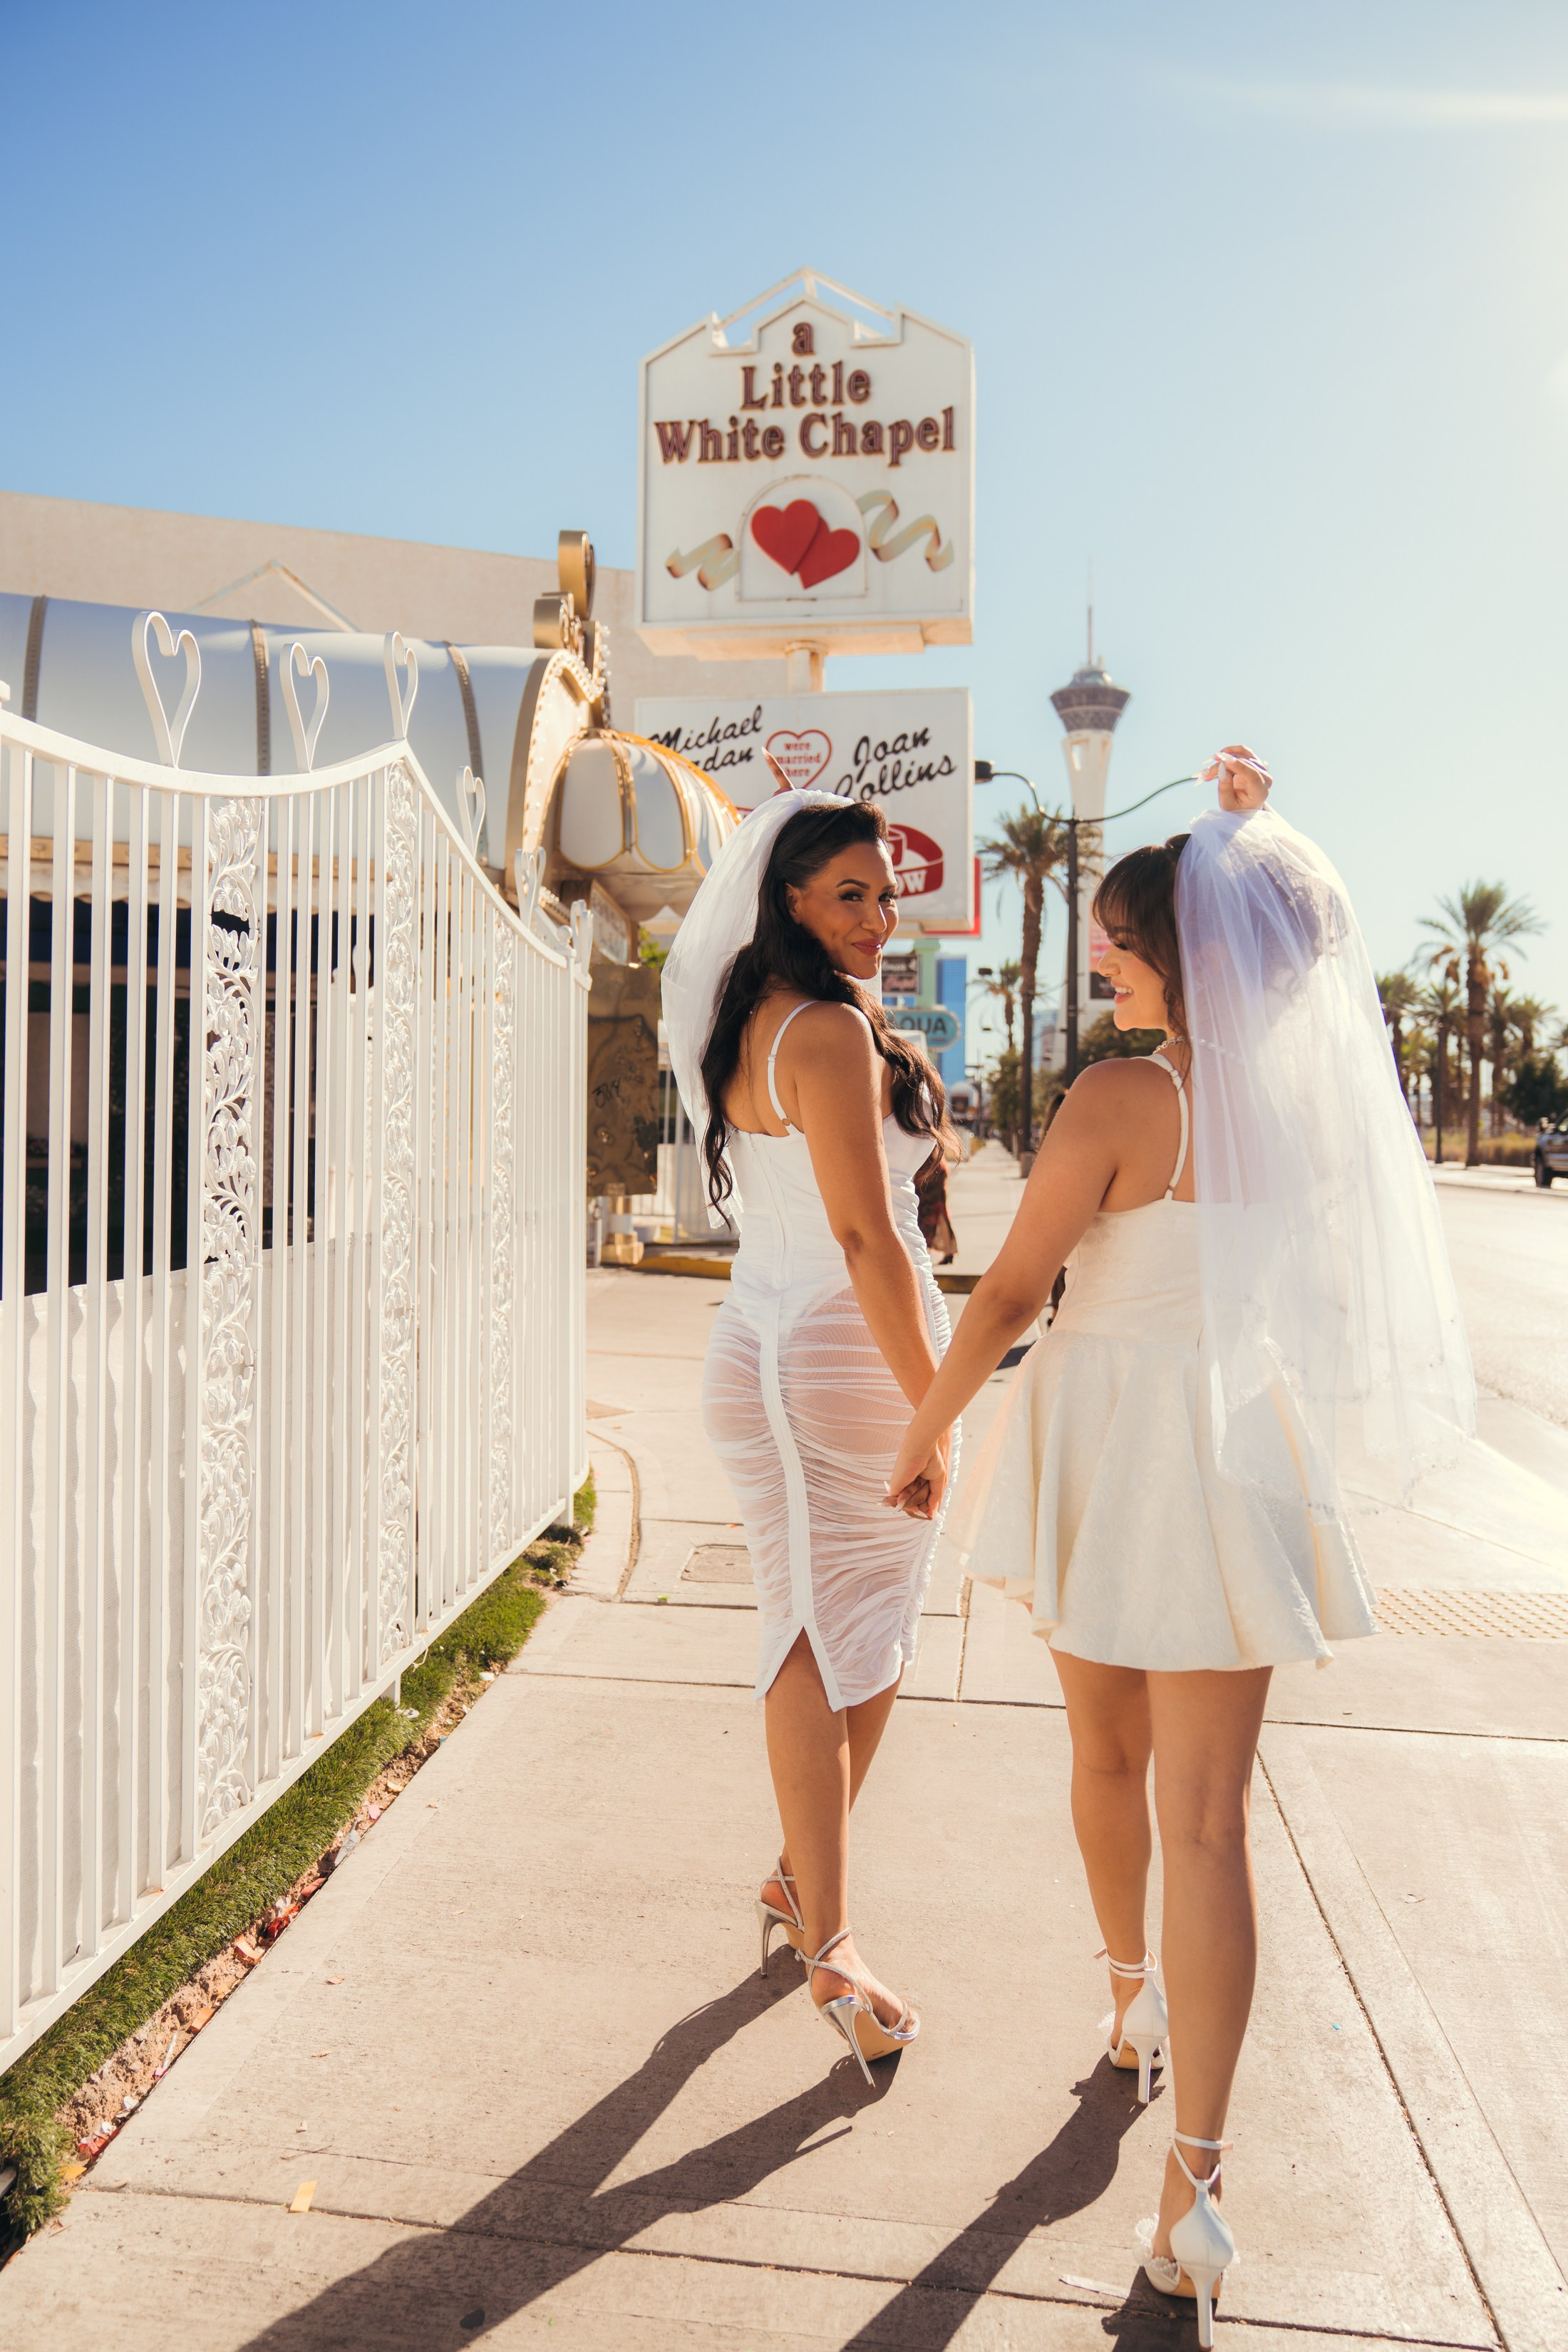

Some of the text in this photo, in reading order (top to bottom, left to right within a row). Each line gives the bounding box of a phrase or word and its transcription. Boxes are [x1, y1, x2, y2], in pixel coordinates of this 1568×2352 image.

[792, 322, 814, 356] a
[741, 360, 871, 411] Little
[654, 407, 955, 467] White Chapel
[648, 704, 762, 753] Michael
[691, 746, 753, 772] dan
[775, 753, 821, 764] married
[785, 742, 810, 751] were
[853, 727, 932, 783] Joan
[786, 767, 810, 776] here
